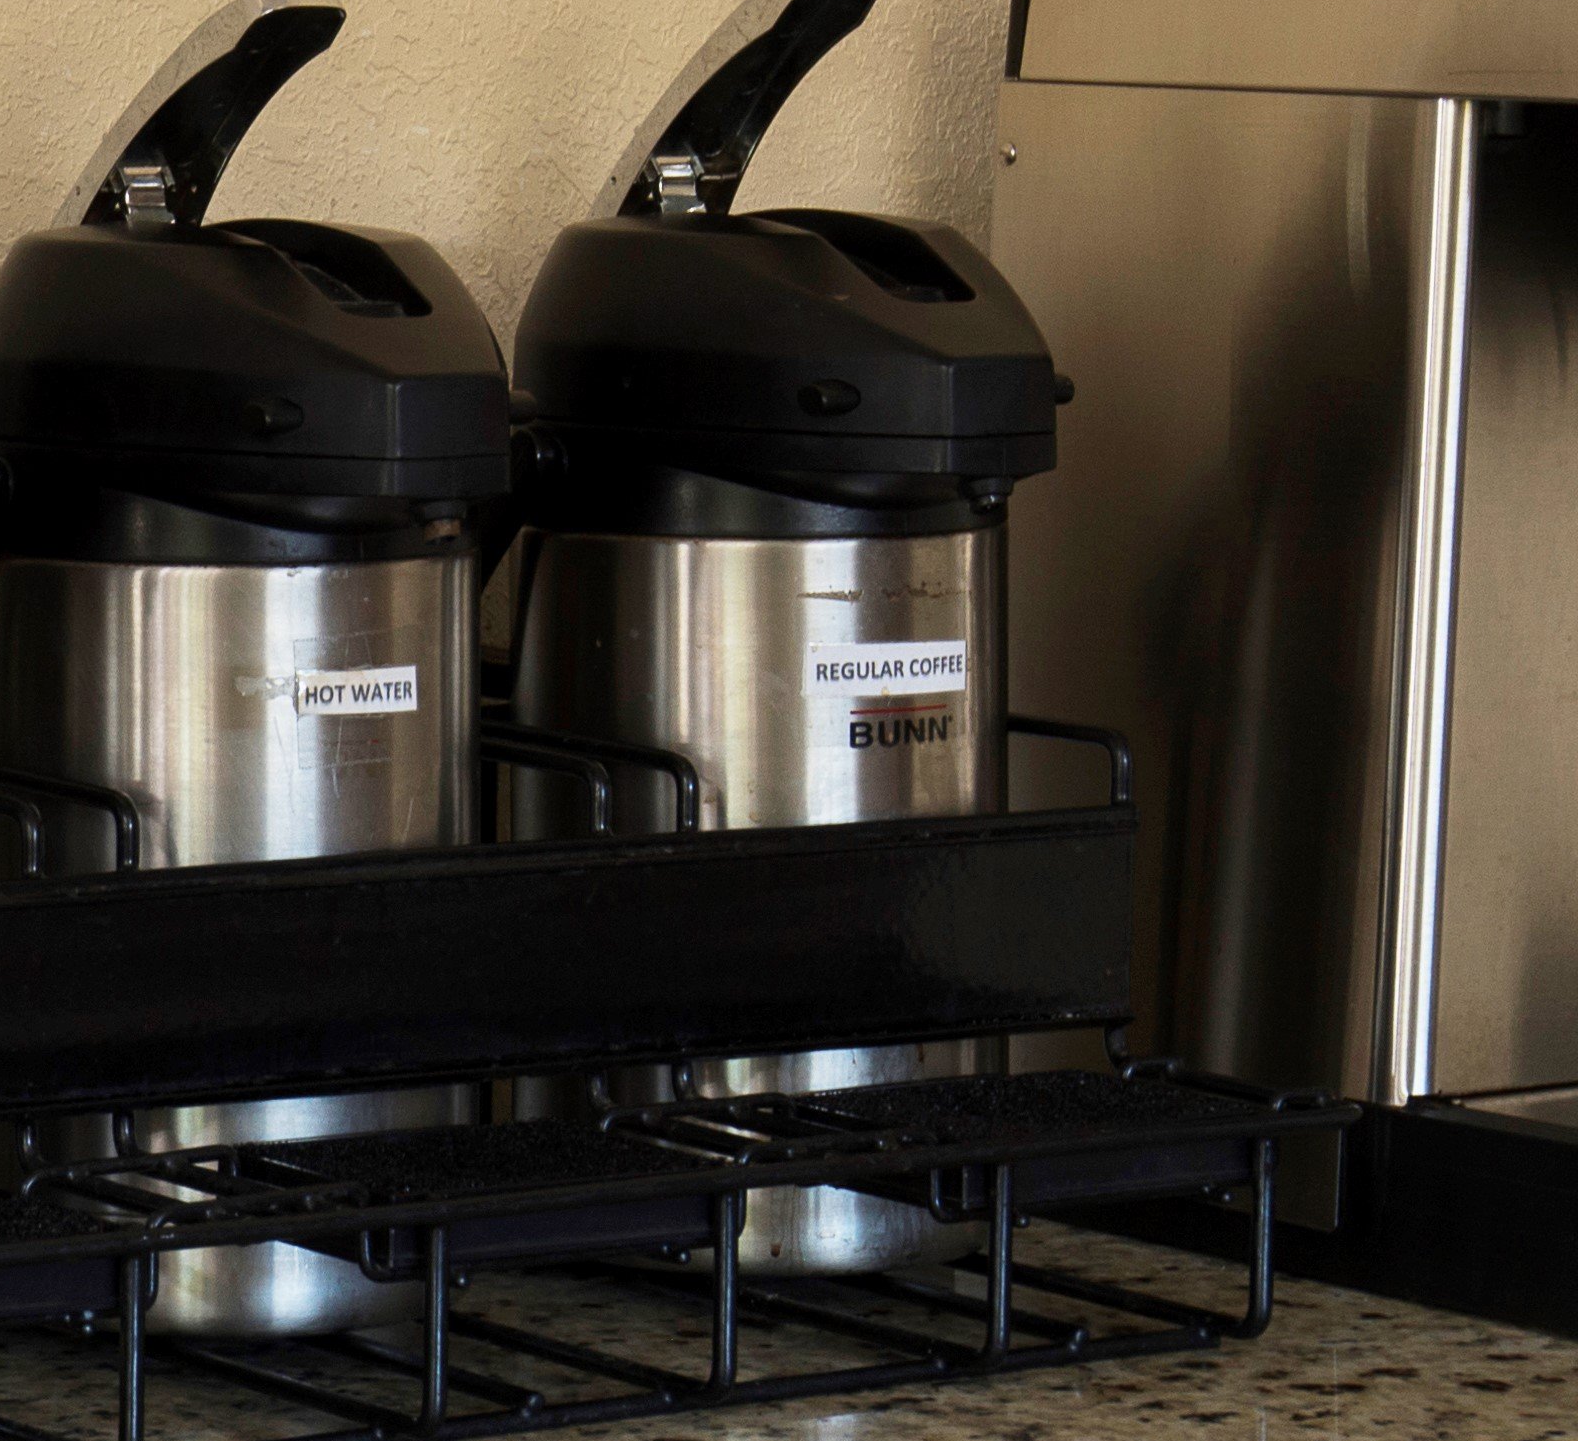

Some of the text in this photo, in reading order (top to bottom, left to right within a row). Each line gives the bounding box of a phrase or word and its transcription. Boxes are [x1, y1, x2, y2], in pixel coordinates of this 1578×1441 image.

[816, 654, 963, 681] REGULAR COFFEE
[305, 680, 412, 706] HOT WATER
[849, 715, 947, 748] BUNN
